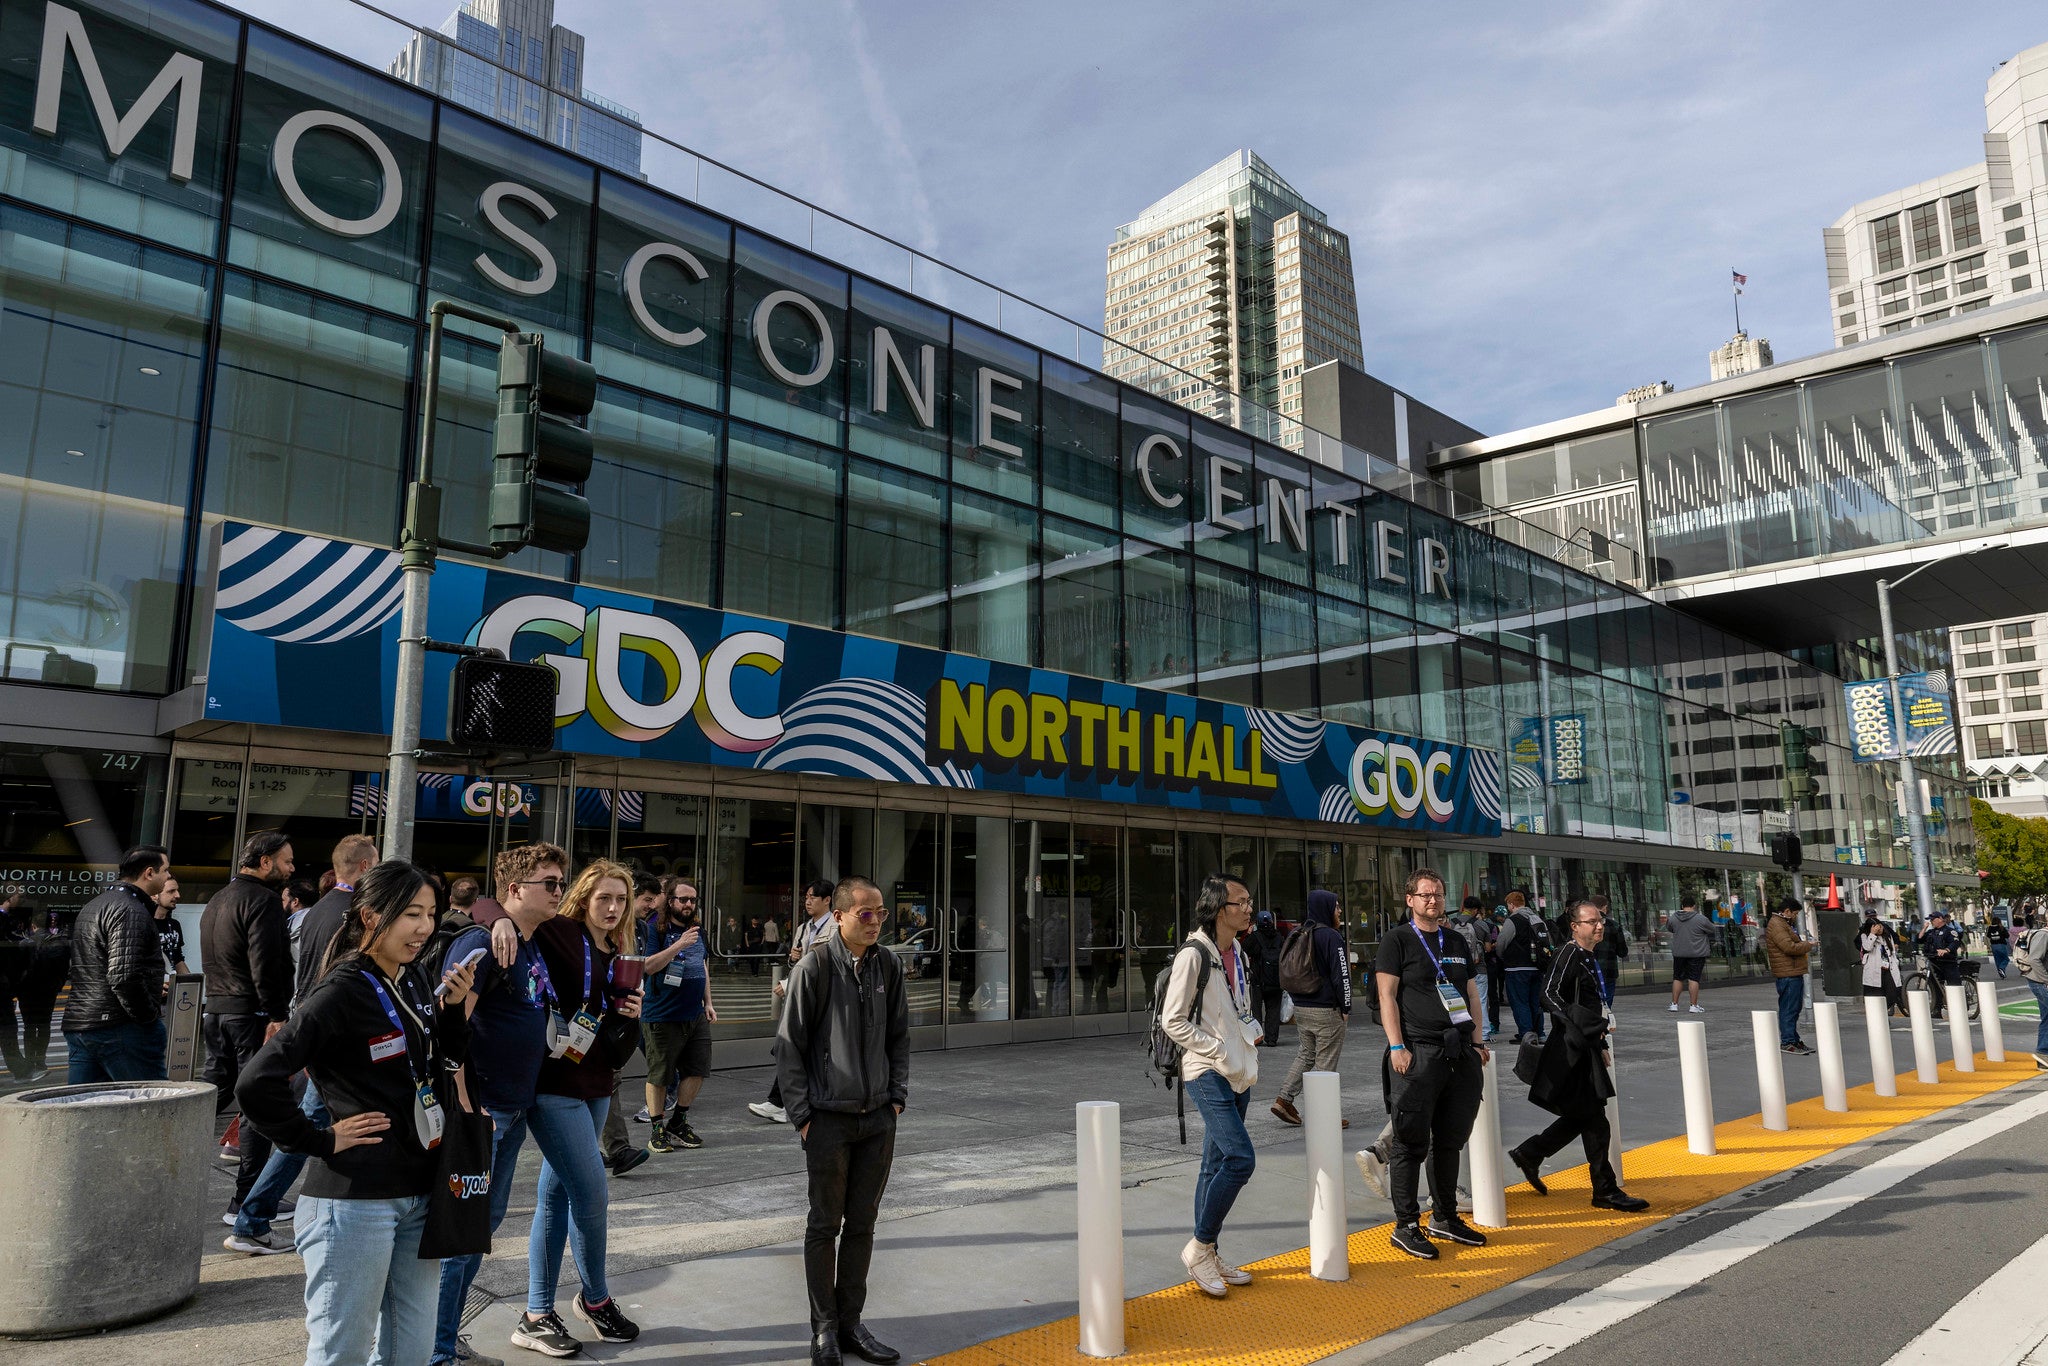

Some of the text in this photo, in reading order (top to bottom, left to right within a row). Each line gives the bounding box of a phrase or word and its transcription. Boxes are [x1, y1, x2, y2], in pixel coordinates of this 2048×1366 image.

[32, 1, 1450, 600] MOSCONE CENTER
[466, 594, 787, 753] GDC
[1850, 684, 1884, 699] GDC
[1852, 696, 1885, 711] GDC
[1853, 707, 1887, 722] GDC
[1855, 719, 1889, 733] GDC
[930, 678, 1279, 795] NORTH HALL
[1856, 730, 1891, 745] GDC
[1857, 742, 1892, 756] GDC
[101, 753, 142, 770] 747
[281, 765, 310, 776] Halls
[212, 776, 287, 791] Roos 1-25
[1348, 737, 1455, 823] GDC
[461, 781, 531, 818] GD
[68, 870, 120, 882] LOBB
[1337, 946, 1348, 976] FROZEN
[1342, 977, 1351, 1007] DISTRICT
[577, 1015, 597, 1031] GDC
